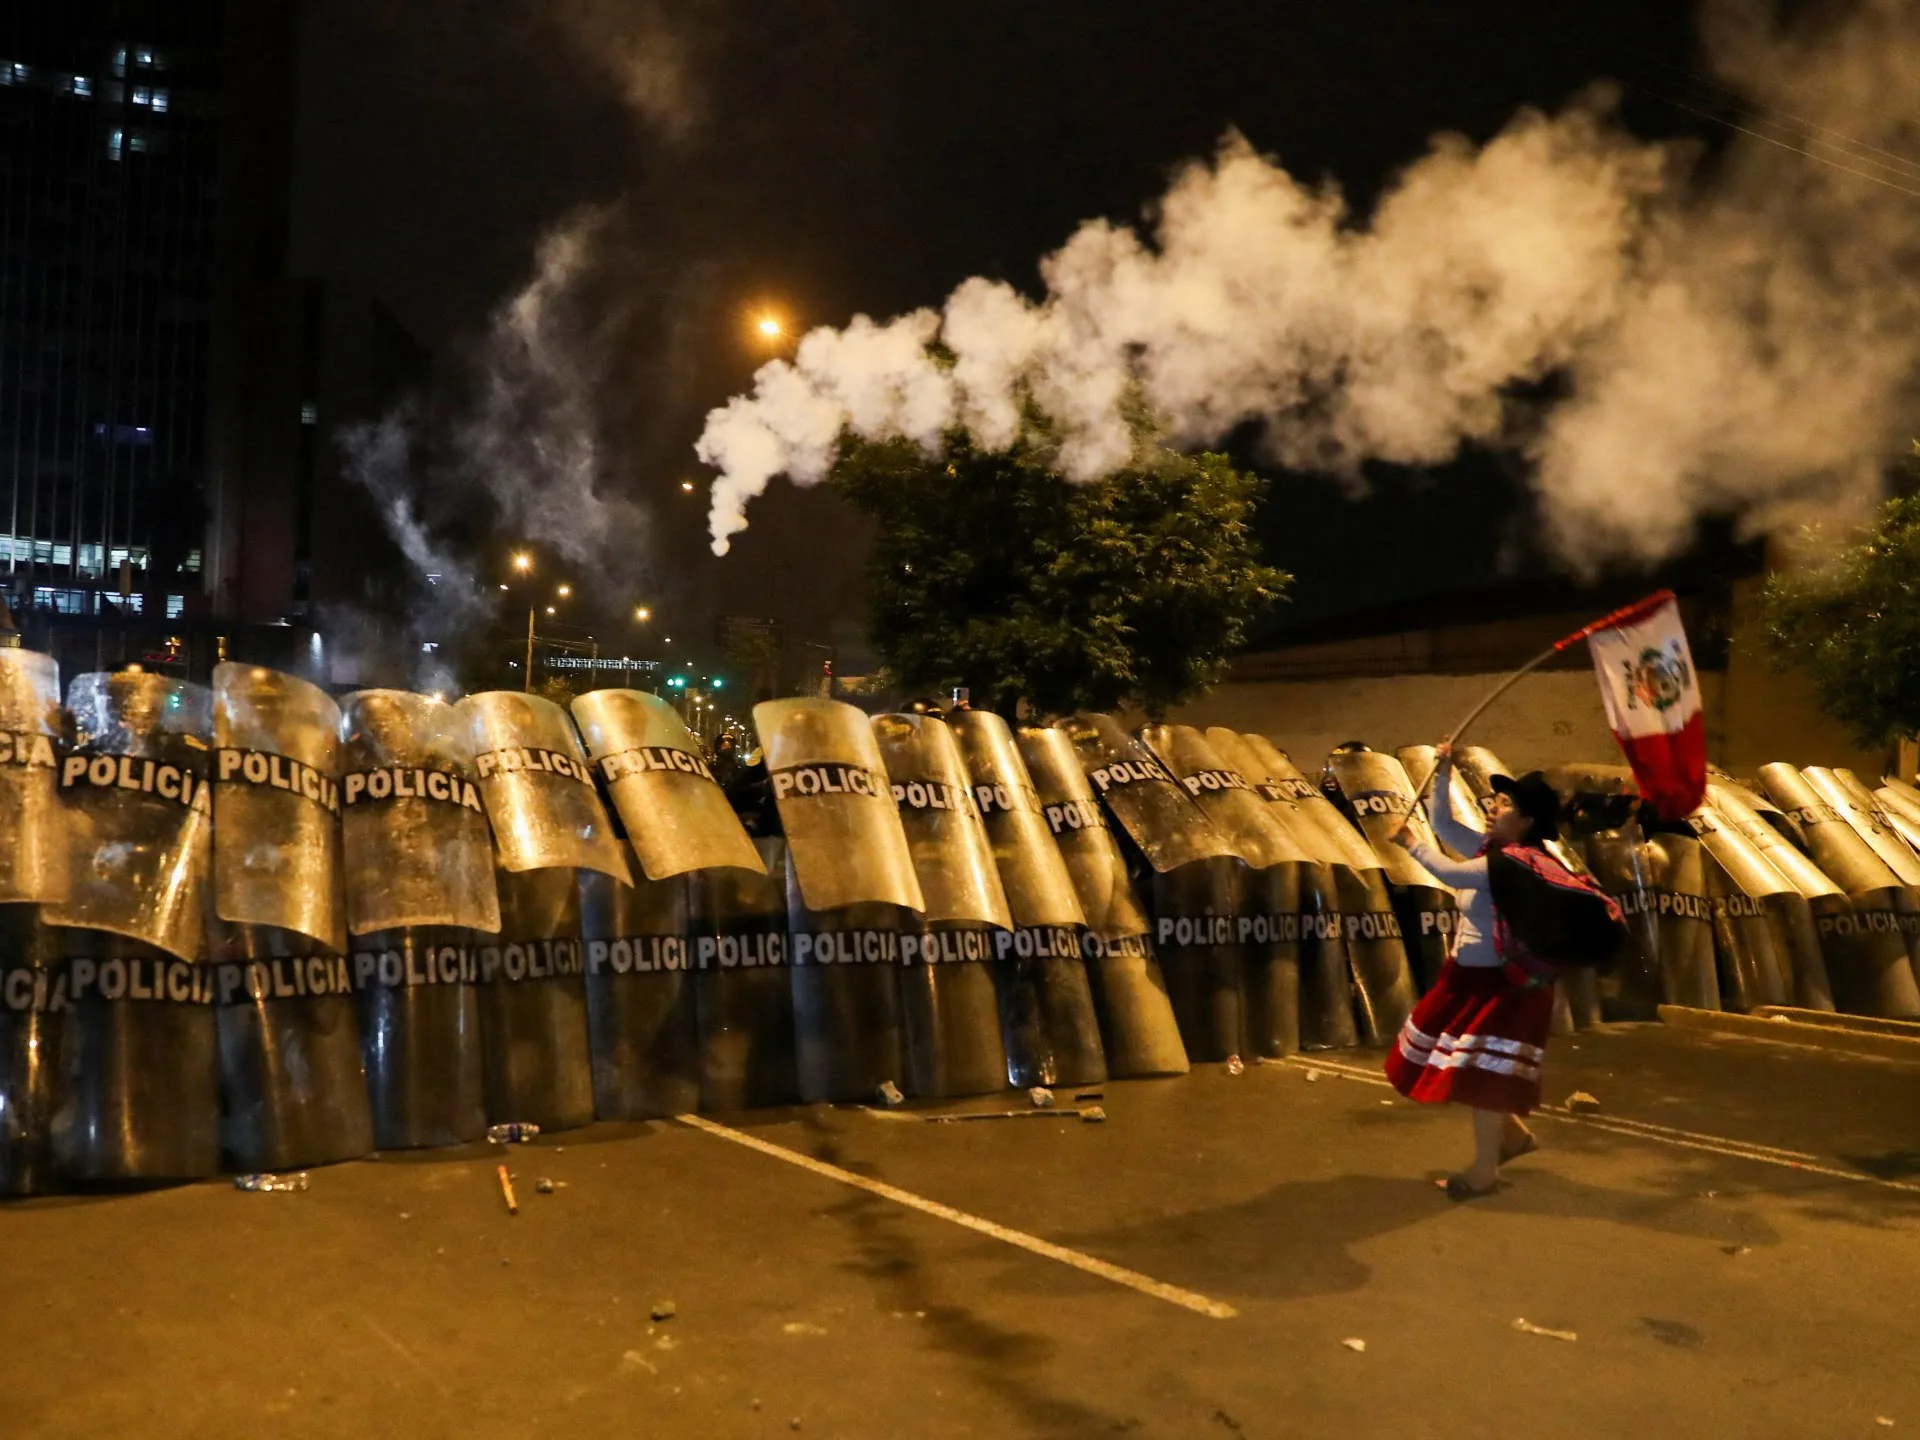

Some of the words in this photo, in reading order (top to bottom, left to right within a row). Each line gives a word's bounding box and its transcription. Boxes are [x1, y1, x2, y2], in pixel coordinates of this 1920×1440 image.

[219, 749, 339, 811] POLICIA
[477, 748, 594, 790] POLICIA
[601, 748, 716, 784] POLICIA
[1091, 761, 1170, 791] POLICI
[1182, 771, 1251, 796] POLIC
[62, 755, 211, 816] POLICIA
[346, 768, 482, 812] POLICIA
[1818, 911, 1900, 939] POLICIA
[794, 930, 898, 965] POLICIA
[1082, 930, 1153, 959] OLICI
[218, 956, 352, 1004] POLICIA
